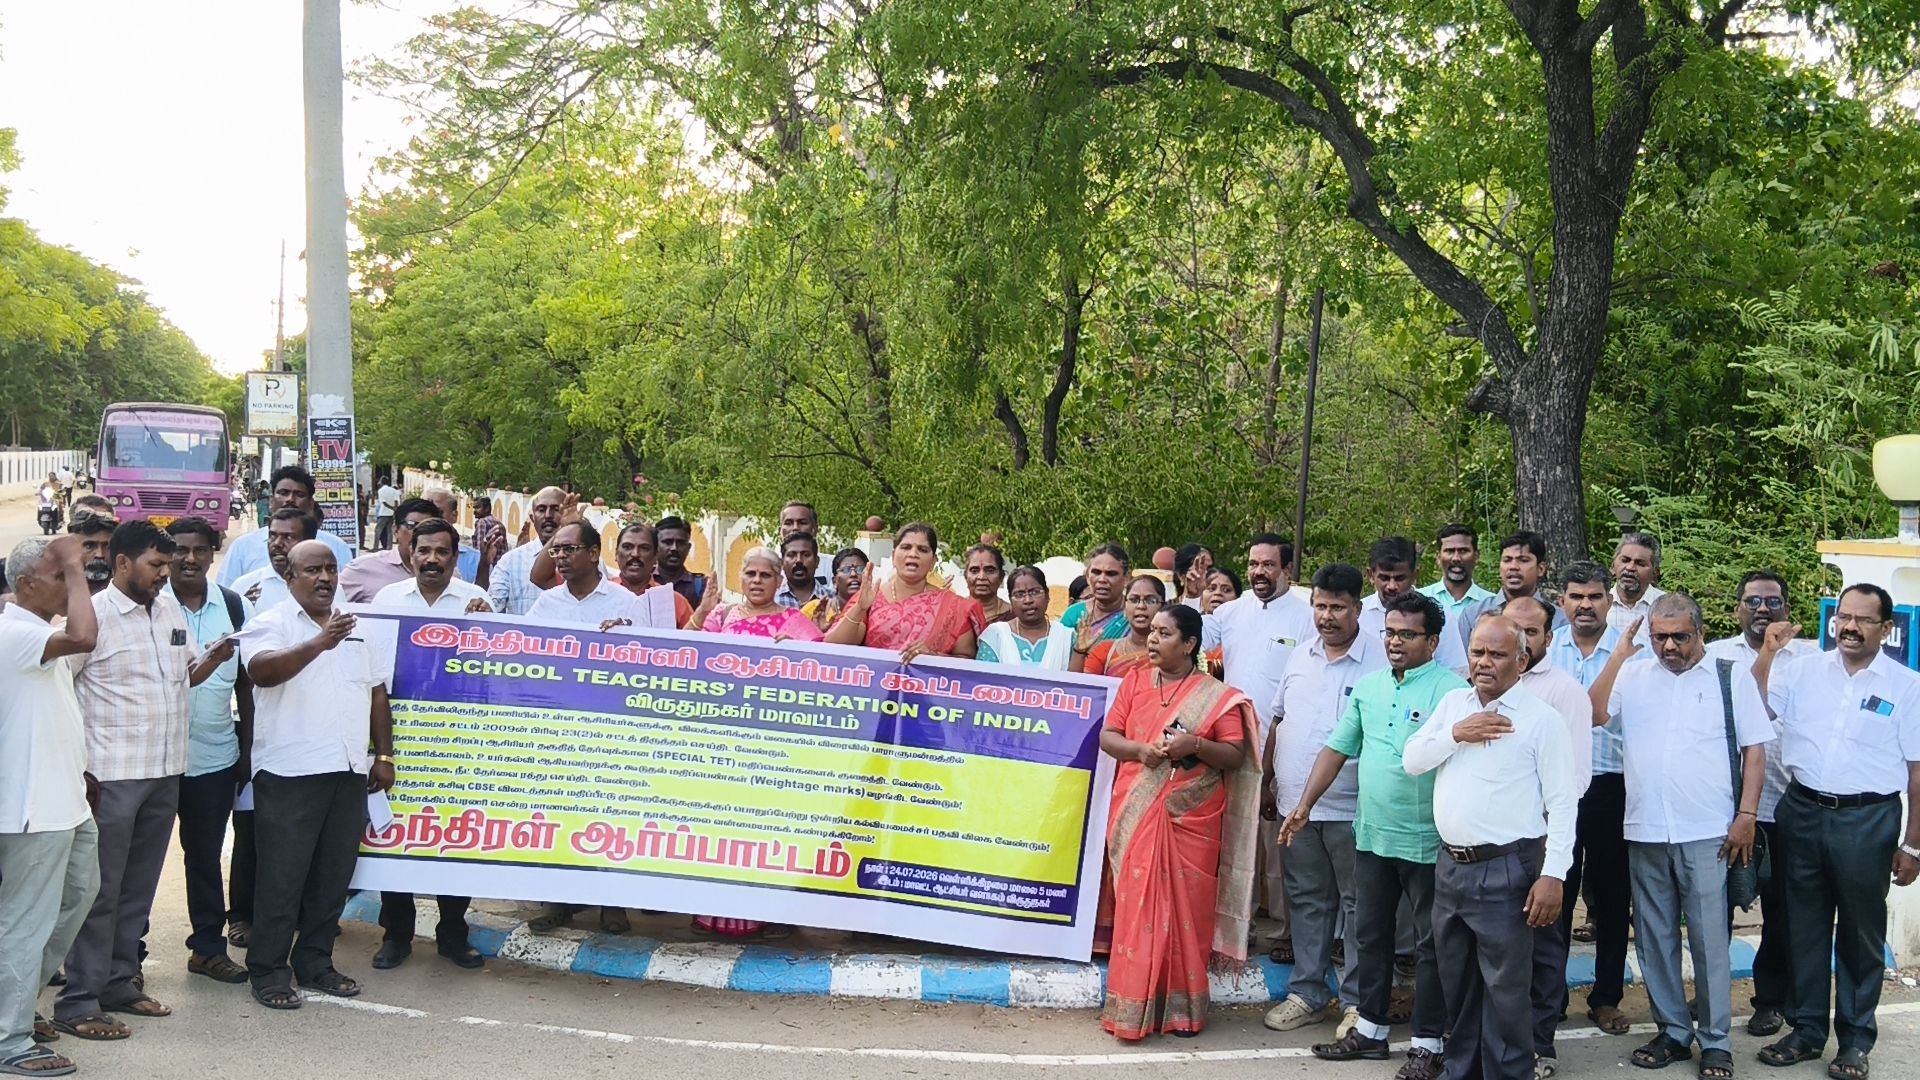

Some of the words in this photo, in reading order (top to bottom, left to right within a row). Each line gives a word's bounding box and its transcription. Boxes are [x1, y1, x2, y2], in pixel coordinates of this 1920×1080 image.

[311, 440, 319, 460] LED
[317, 439, 351, 459] TV
[317, 459, 346, 468] 5999
[410, 623, 581, 658] இந்தியப்
[588, 640, 699, 669] பள்ளி
[705, 652, 875, 687] ஆசிரியர்
[880, 672, 1092, 719] கூட்டமைப்பு
[445, 659, 562, 681] SCHOOL
[743, 685, 918, 718] FEDERATION
[928, 706, 964, 723] OF
[974, 711, 1051, 735] INDIA
[625, 693, 754, 719] விருதுநகர்
[759, 707, 860, 731] மாவட்டம்
[399, 719, 446, 729] உரிமைச்
[449, 722, 479, 731] சட்டம்
[482, 724, 527, 735] 2009ன்
[530, 725, 559, 737] பிரிவு
[561, 728, 603, 740] 23(2)ல்
[606, 733, 637, 743] சட்டத்
[639, 735, 688, 748] திருத்தம்
[690, 740, 731, 753] செய்திட
[734, 744, 789, 760] வேண்டும்.
[411, 704, 489, 718] தேர்விலிருந்து
[491, 710, 540, 720] பணியில்
[542, 712, 575, 722] உள்ள
[578, 714, 673, 731] ஆசிரியர்களுக்கு
[678, 725, 761, 741] விலக்களிக்கும்
[764, 732, 816, 748] வகையில்
[818, 739, 870, 753] விரைவில்
[392, 735, 450, 746] நடைபெற்ற
[452, 738, 483, 748] சிறப்பு
[486, 738, 535, 750] ஆசிரியர்
[537, 742, 576, 753] தகுதித்
[578, 744, 650, 758] தேர்வுக்கான
[652, 750, 706, 765] (SPECIAL
[710, 755, 736, 769] TET)
[892, 778, 943, 793] வேண்டும்.
[454, 765, 471, 778] நீட்
[473, 768, 518, 779] தேர்வை
[520, 772, 548, 784] ரத்து
[550, 774, 591, 785] செய்திட
[593, 775, 651, 789] வேண்டும்.
[537, 755, 622, 771] ஆகியவற்றுக்கு
[624, 763, 668, 776] கூடுதல்
[669, 766, 748, 784] மதிப்பெண்கள்
[750, 775, 820, 793] (Weightage
[823, 783, 866, 799] marks)
[910, 794, 963, 810] வேண்டும்!
[399, 793, 446, 805] நோக்கிப்
[448, 796, 488, 808] பேரணி
[490, 799, 528, 810] சென்ற
[530, 801, 599, 814] மாணவர்கள்
[602, 806, 641, 818] மீதான
[643, 811, 711, 824] தாக்குதலை
[437, 781, 466, 792] கசிவு
[467, 783, 495, 793] CBSE
[498, 784, 565, 797] விடைத்தாள்
[567, 787, 616, 800] மதிப்பீட்டு
[733, 805, 808, 822] பொறுப்பேற்று
[810, 813, 852, 826] ஒன்றிய
[931, 827, 960, 840] பதவி
[994, 836, 1051, 852] வேண்டும்!
[570, 820, 851, 878] ஆர்ப்பாட்டம்
[865, 863, 883, 873] நாள்
[889, 865, 938, 880] 24.07.2026
[1009, 882, 1037, 894] மாலை
[1039, 887, 1044, 895] 5
[1046, 888, 1067, 898] மணி
[933, 884, 968, 897] ஆட்சியர்
[1007, 893, 1050, 909] விருதுநகர்
